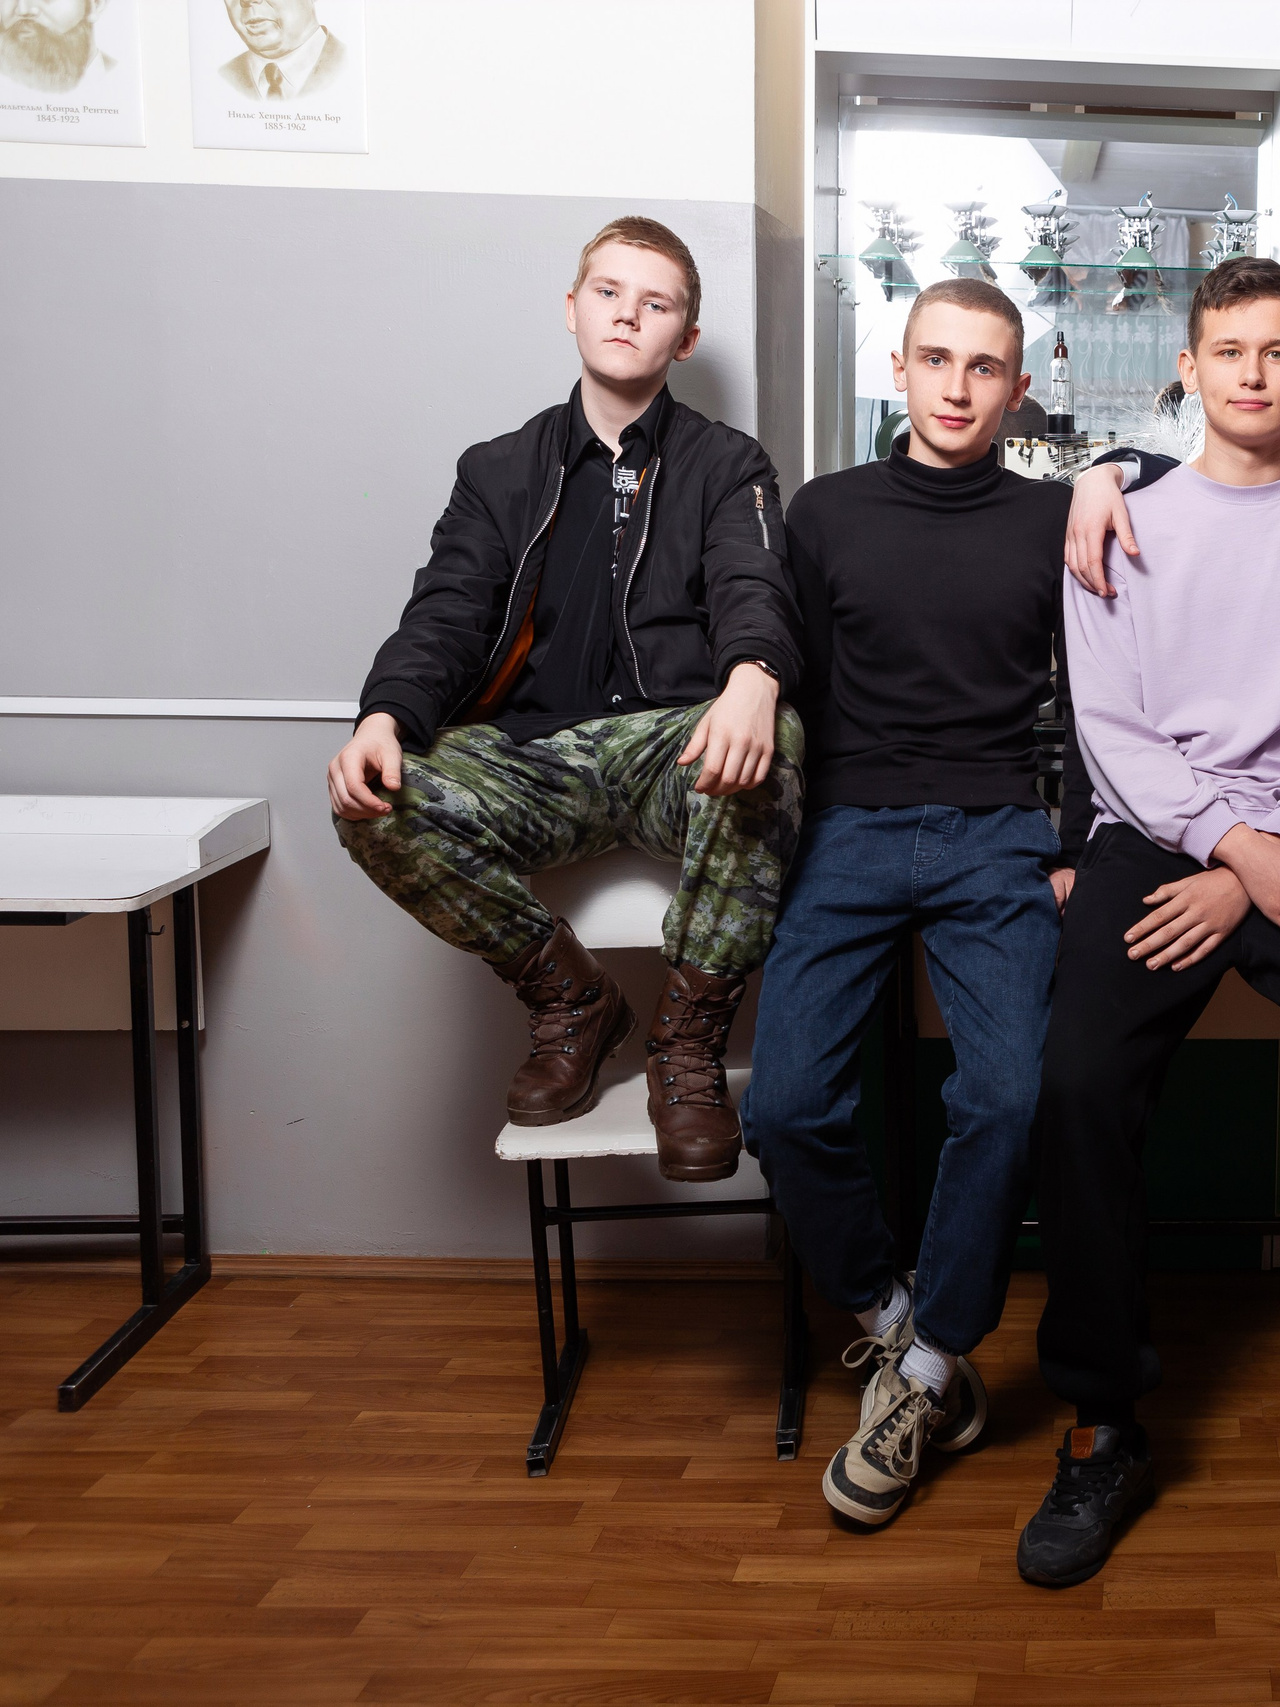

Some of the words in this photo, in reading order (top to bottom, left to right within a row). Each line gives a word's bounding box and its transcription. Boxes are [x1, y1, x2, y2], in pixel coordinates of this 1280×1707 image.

[46, 104, 80, 114] Конрад
[83, 105, 119, 115] Рентген
[37, 114, 80, 124] 1845-1923
[228, 110, 256, 120] Нильс
[259, 111, 292, 122] Хенрик
[295, 112, 322, 122] Давид
[325, 113, 342, 124] Бор
[264, 122, 307, 131] 1885-1962
